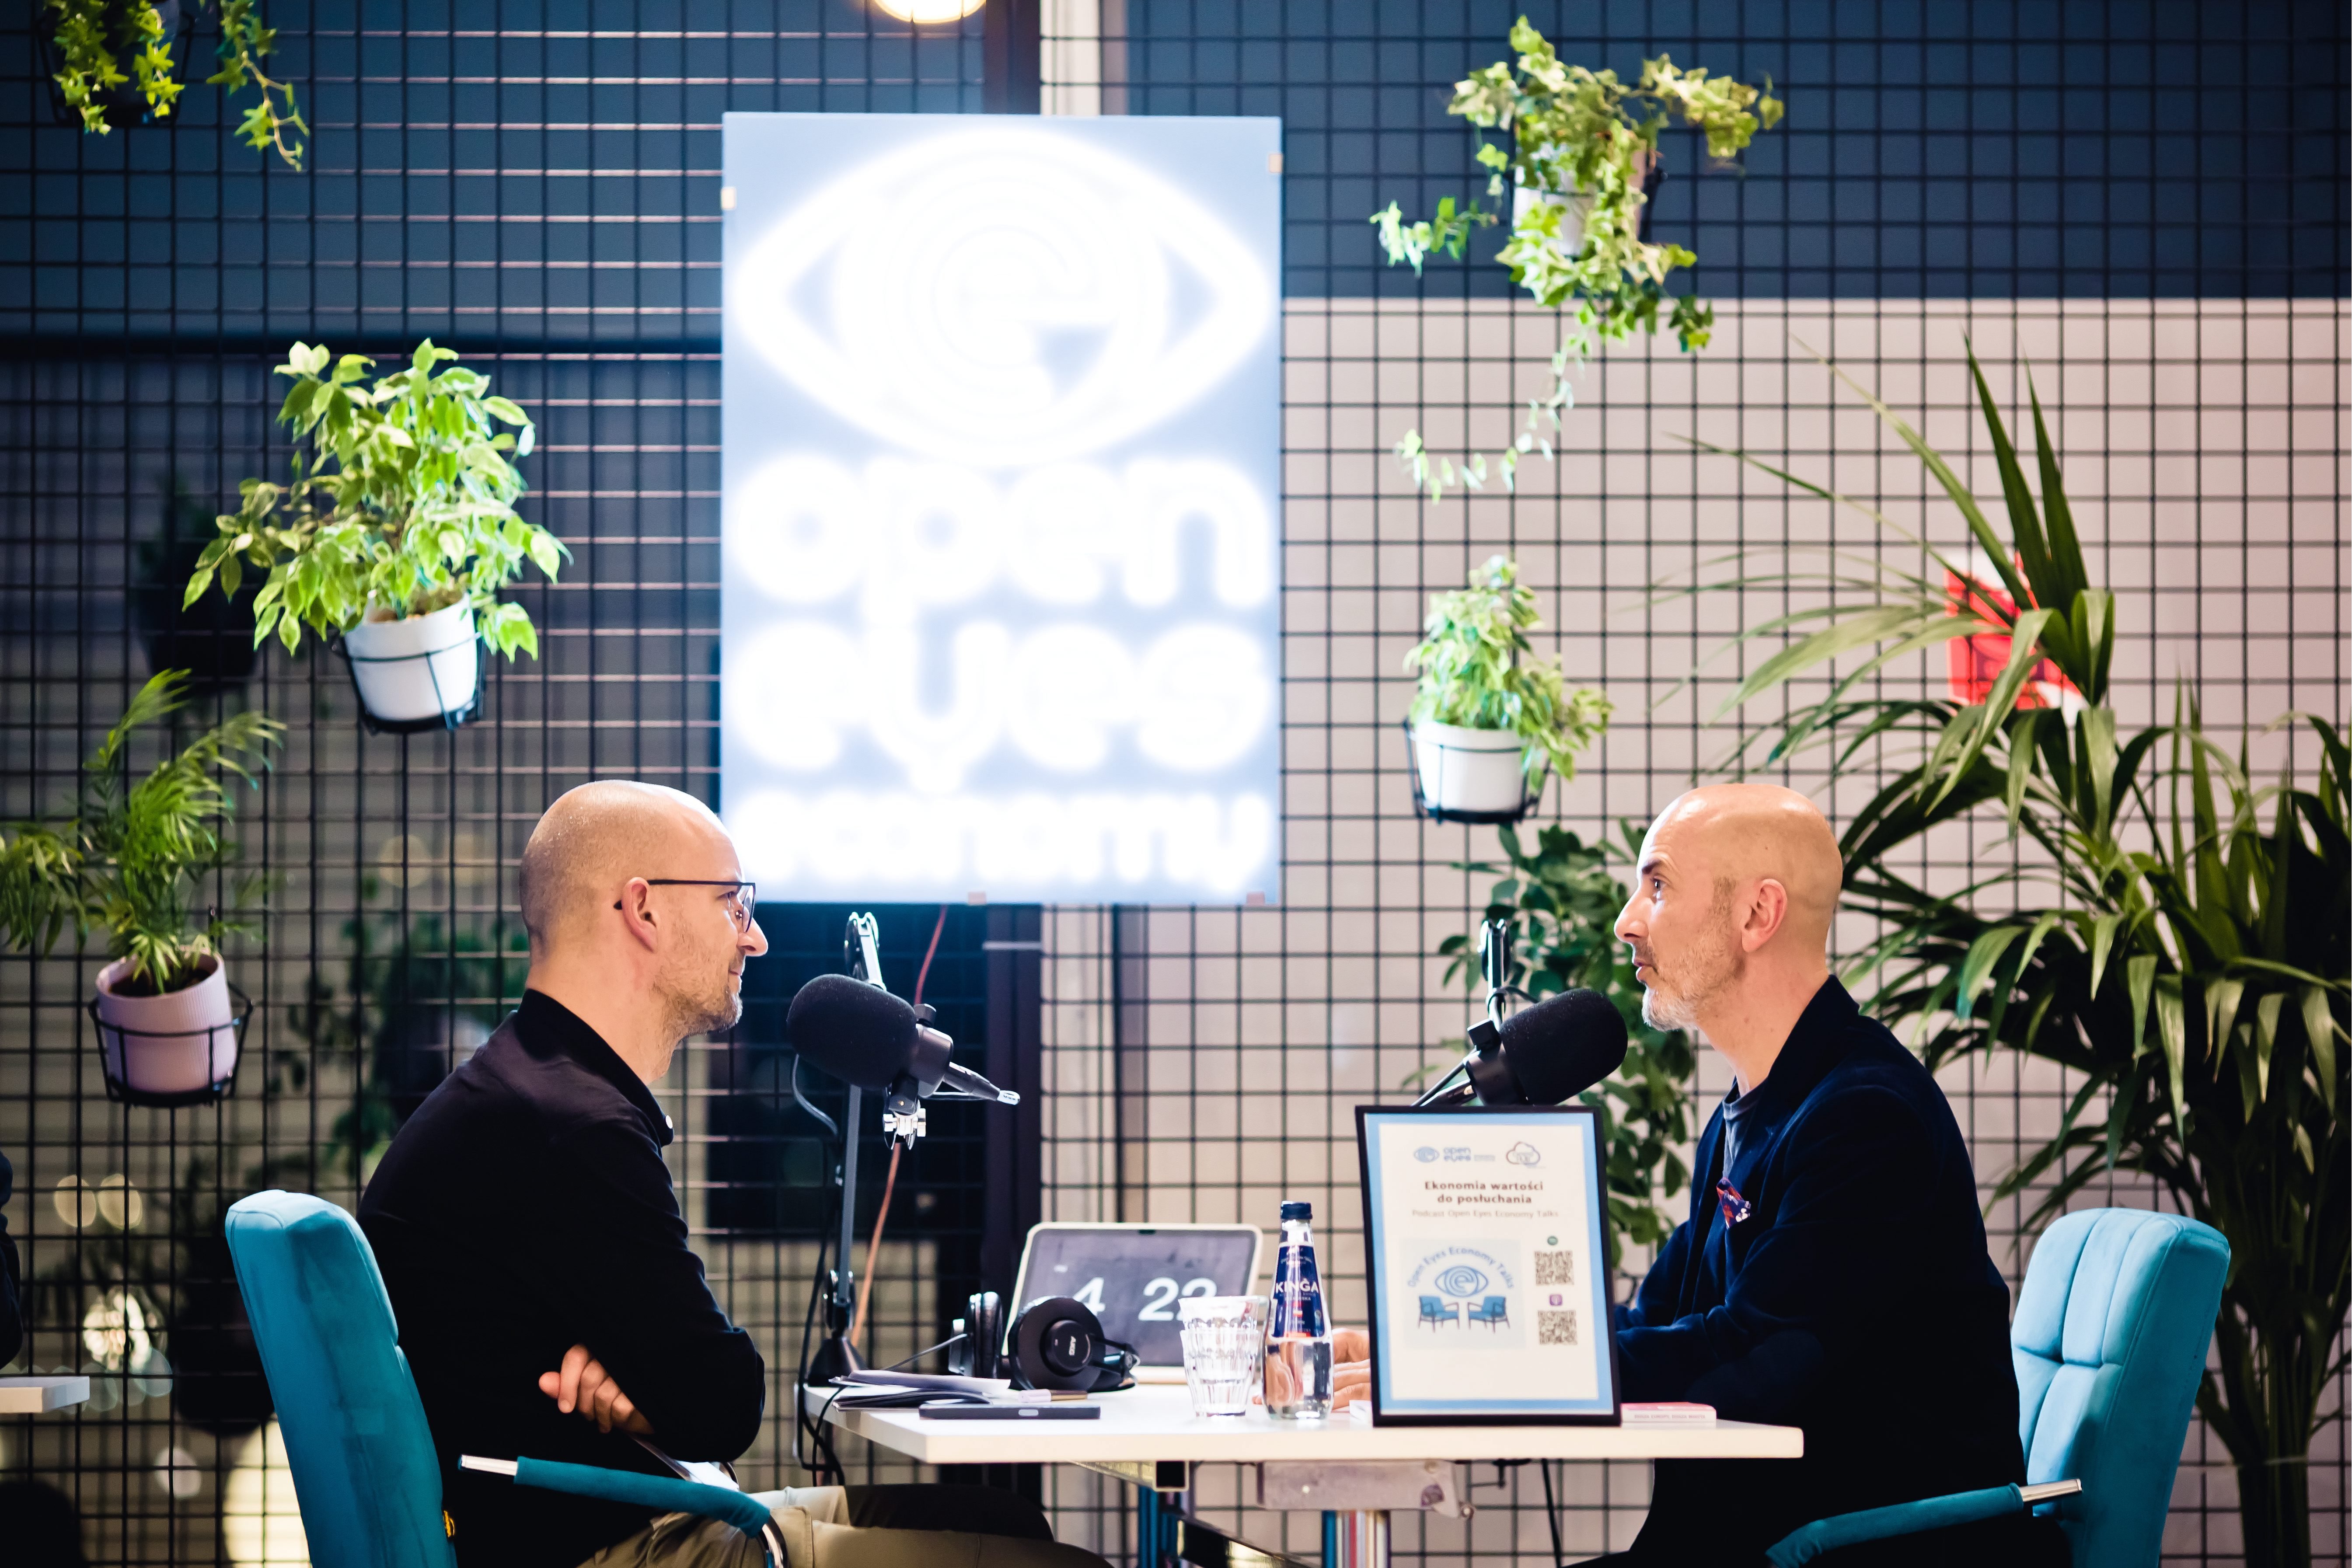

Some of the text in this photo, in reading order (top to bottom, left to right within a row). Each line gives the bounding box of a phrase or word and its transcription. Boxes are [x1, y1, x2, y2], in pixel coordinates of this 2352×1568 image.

[728, 455, 1270, 623] open
[727, 621, 1270, 791] eyes
[727, 791, 1270, 893] economy
[1425, 1181, 1543, 1190] Ekonomia wartości
[1437, 1194, 1532, 1205] do posłuchania
[1448, 1209, 1470, 1218] Open
[1473, 1209, 1492, 1218] Eyes
[1495, 1210, 1533, 1218] Economy
[1423, 1251, 1446, 1265] Eyes
[1448, 1247, 1496, 1265] Economy
[1497, 1262, 1514, 1288] Talks
[1275, 1279, 1319, 1293] KINGA
